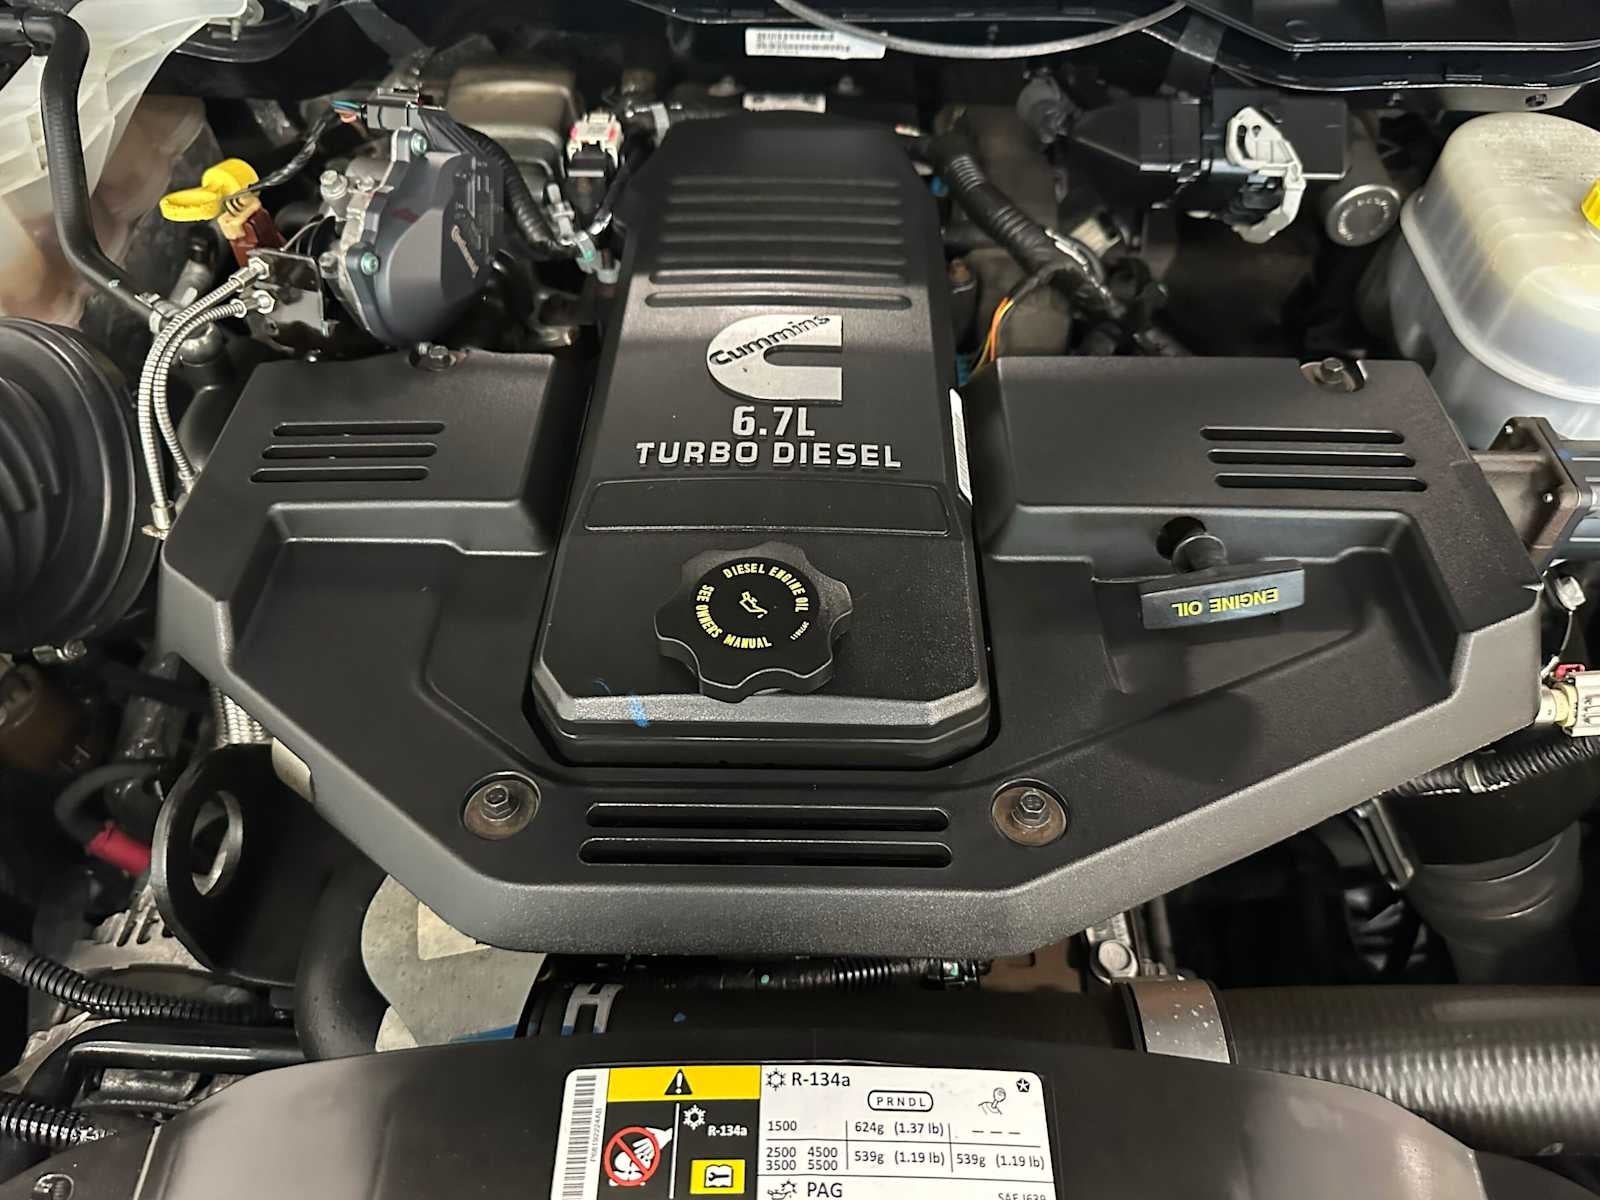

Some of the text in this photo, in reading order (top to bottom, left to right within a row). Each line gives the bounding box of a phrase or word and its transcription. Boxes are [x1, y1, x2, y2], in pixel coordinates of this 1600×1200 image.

[709, 315, 830, 366] Cummins
[732, 405, 816, 438] 6.7L
[636, 441, 902, 469] TURBO DIESEL
[722, 563, 809, 613] DIESEL ENGINE OIL
[1171, 587, 1280, 617] ENGINE OIL
[695, 584, 773, 649] SEE OWNERS MANUAL
[791, 1071, 851, 1087] R-134a
[707, 1124, 748, 1137] R-134a
[768, 1120, 798, 1131] 1500
[855, 1121, 944, 1137] 624g (1.37 lb)
[766, 1147, 838, 1158] 2500 4500
[854, 1150, 945, 1167] 539g (1.19 lb)
[766, 1160, 838, 1171] 3500 5500
[956, 1153, 1045, 1171] 539g (1.19 lb)
[807, 1182, 843, 1198] PAG
